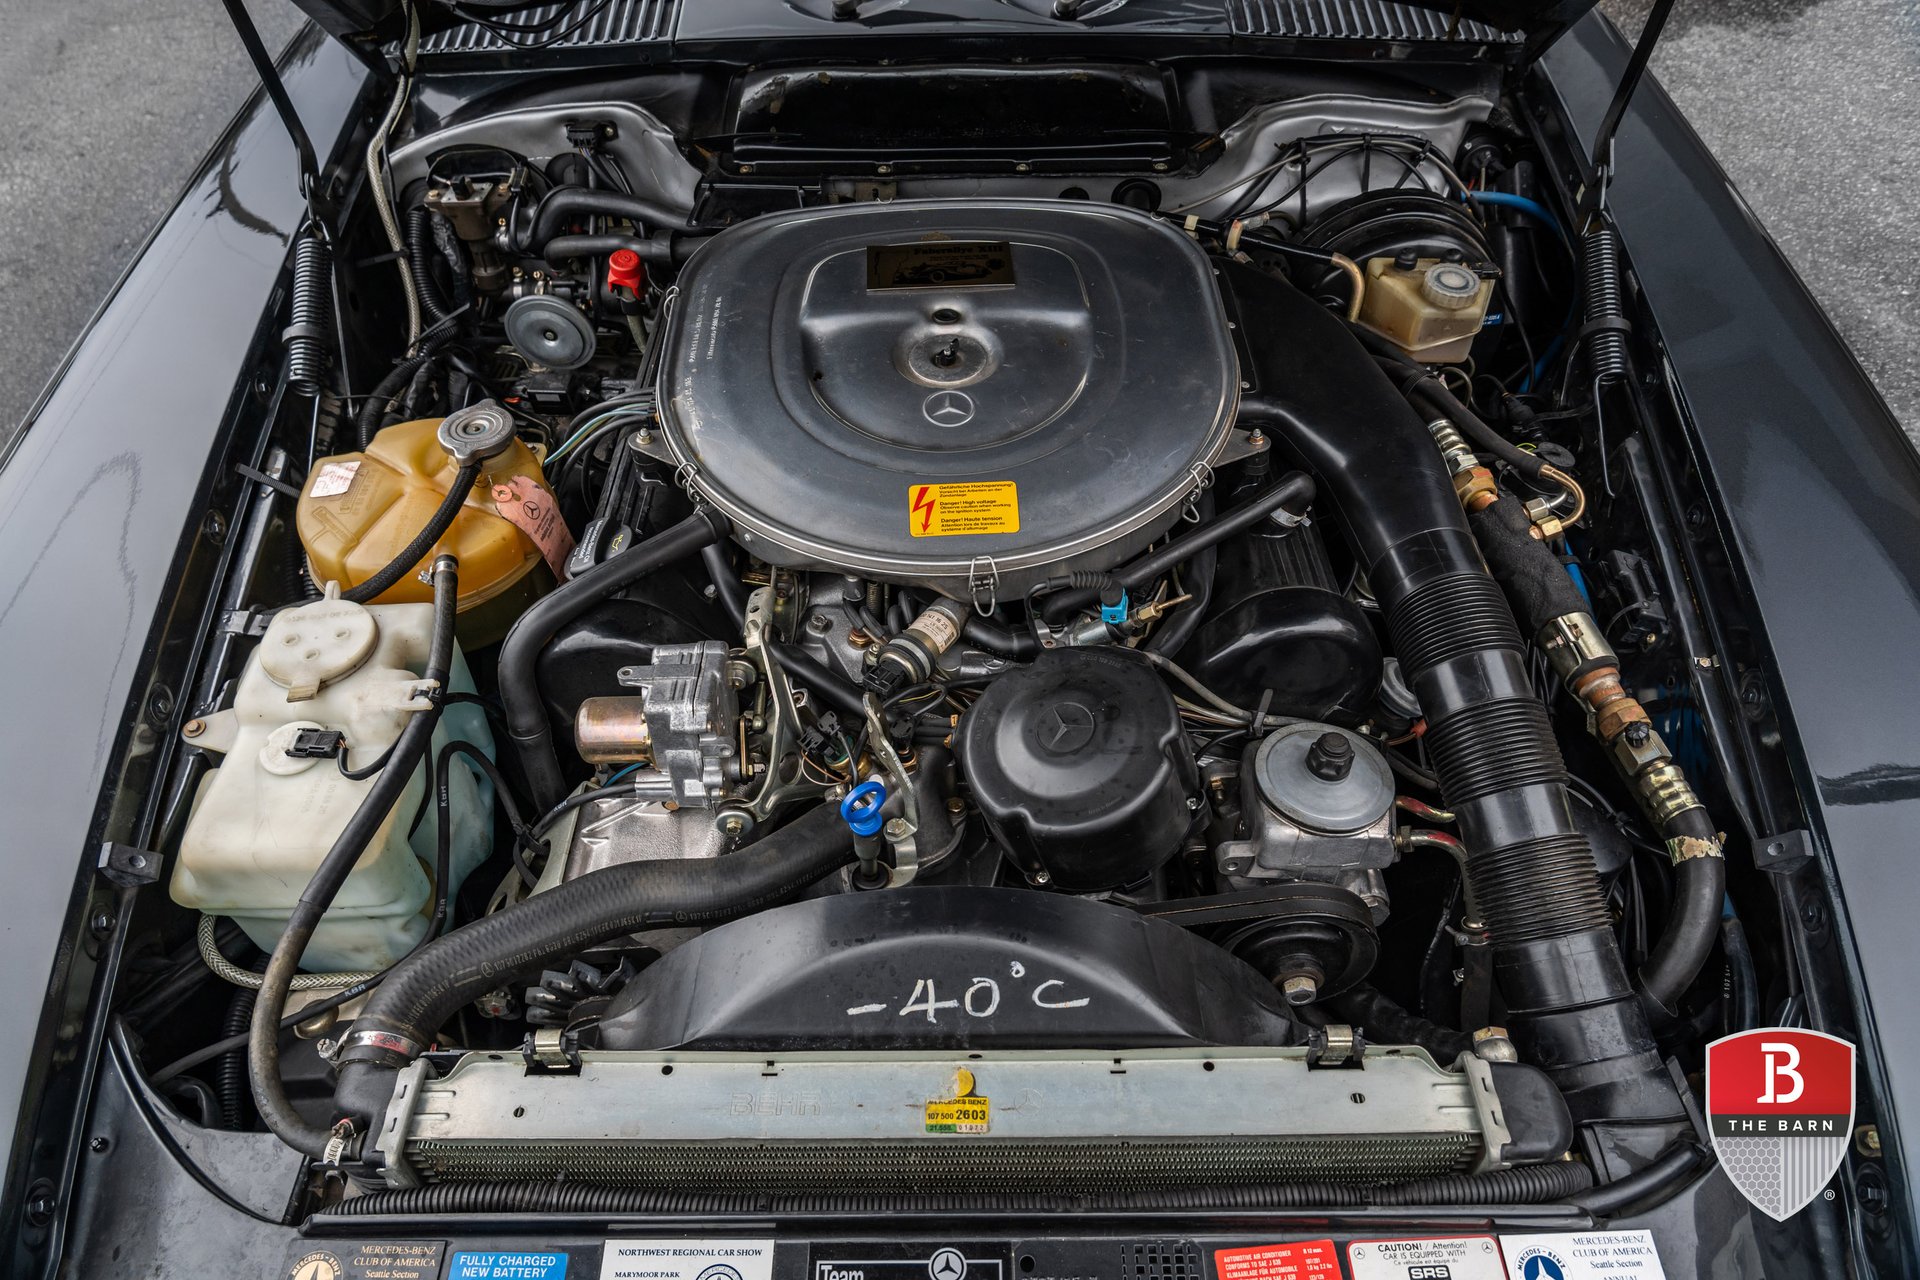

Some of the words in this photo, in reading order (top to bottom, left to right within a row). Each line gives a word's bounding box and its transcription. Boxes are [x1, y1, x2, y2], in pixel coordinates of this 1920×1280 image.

[729, 1089, 821, 1115] BEHR
[956, 1109, 986, 1120] 2603
[1573, 1235, 1646, 1246] MERCEDES-BENZ
[361, 1246, 437, 1255] MERCEDES-BENZ
[1378, 1244, 1422, 1252] CAUTION!
[1572, 1249, 1597, 1258] CLUB
[1599, 1248, 1610, 1257] OF
[1612, 1247, 1653, 1256] AMERICA
[1224, 1253, 1252, 1262] AUTOMOTIVE
[1262, 1250, 1292, 1259] CONDITIONER
[1383, 1252, 1398, 1260] CAR
[1410, 1251, 1444, 1259] EQUIPPED
[1517, 1248, 1541, 1271] MERCEDES
[1548, 1251, 1566, 1269] BENZ
[291, 1253, 325, 1276] MERCEDES
[329, 1257, 341, 1276] BENZ
[354, 1257, 379, 1266] CLUB
[380, 1257, 392, 1266] OF
[394, 1257, 436, 1267] AMERICA
[460, 1256, 495, 1265] FULLY
[499, 1256, 556, 1266] CHARGED
[1590, 1261, 1614, 1269] Seattle
[1616, 1260, 1643, 1268] Section
[1225, 1262, 1250, 1271] CONFORMS
[1226, 1269, 1258, 1278] KLIMAANLAGE
[1259, 1267, 1268, 1275] FÜR
[1270, 1265, 1298, 1275] AUTOMOBILE
[365, 1270, 391, 1279] Seattle
[392, 1270, 419, 1279] Section
[462, 1267, 492, 1277] NEW
[493, 1268, 548, 1277] BATTERY
[1410, 1267, 1449, 1279] SRS
